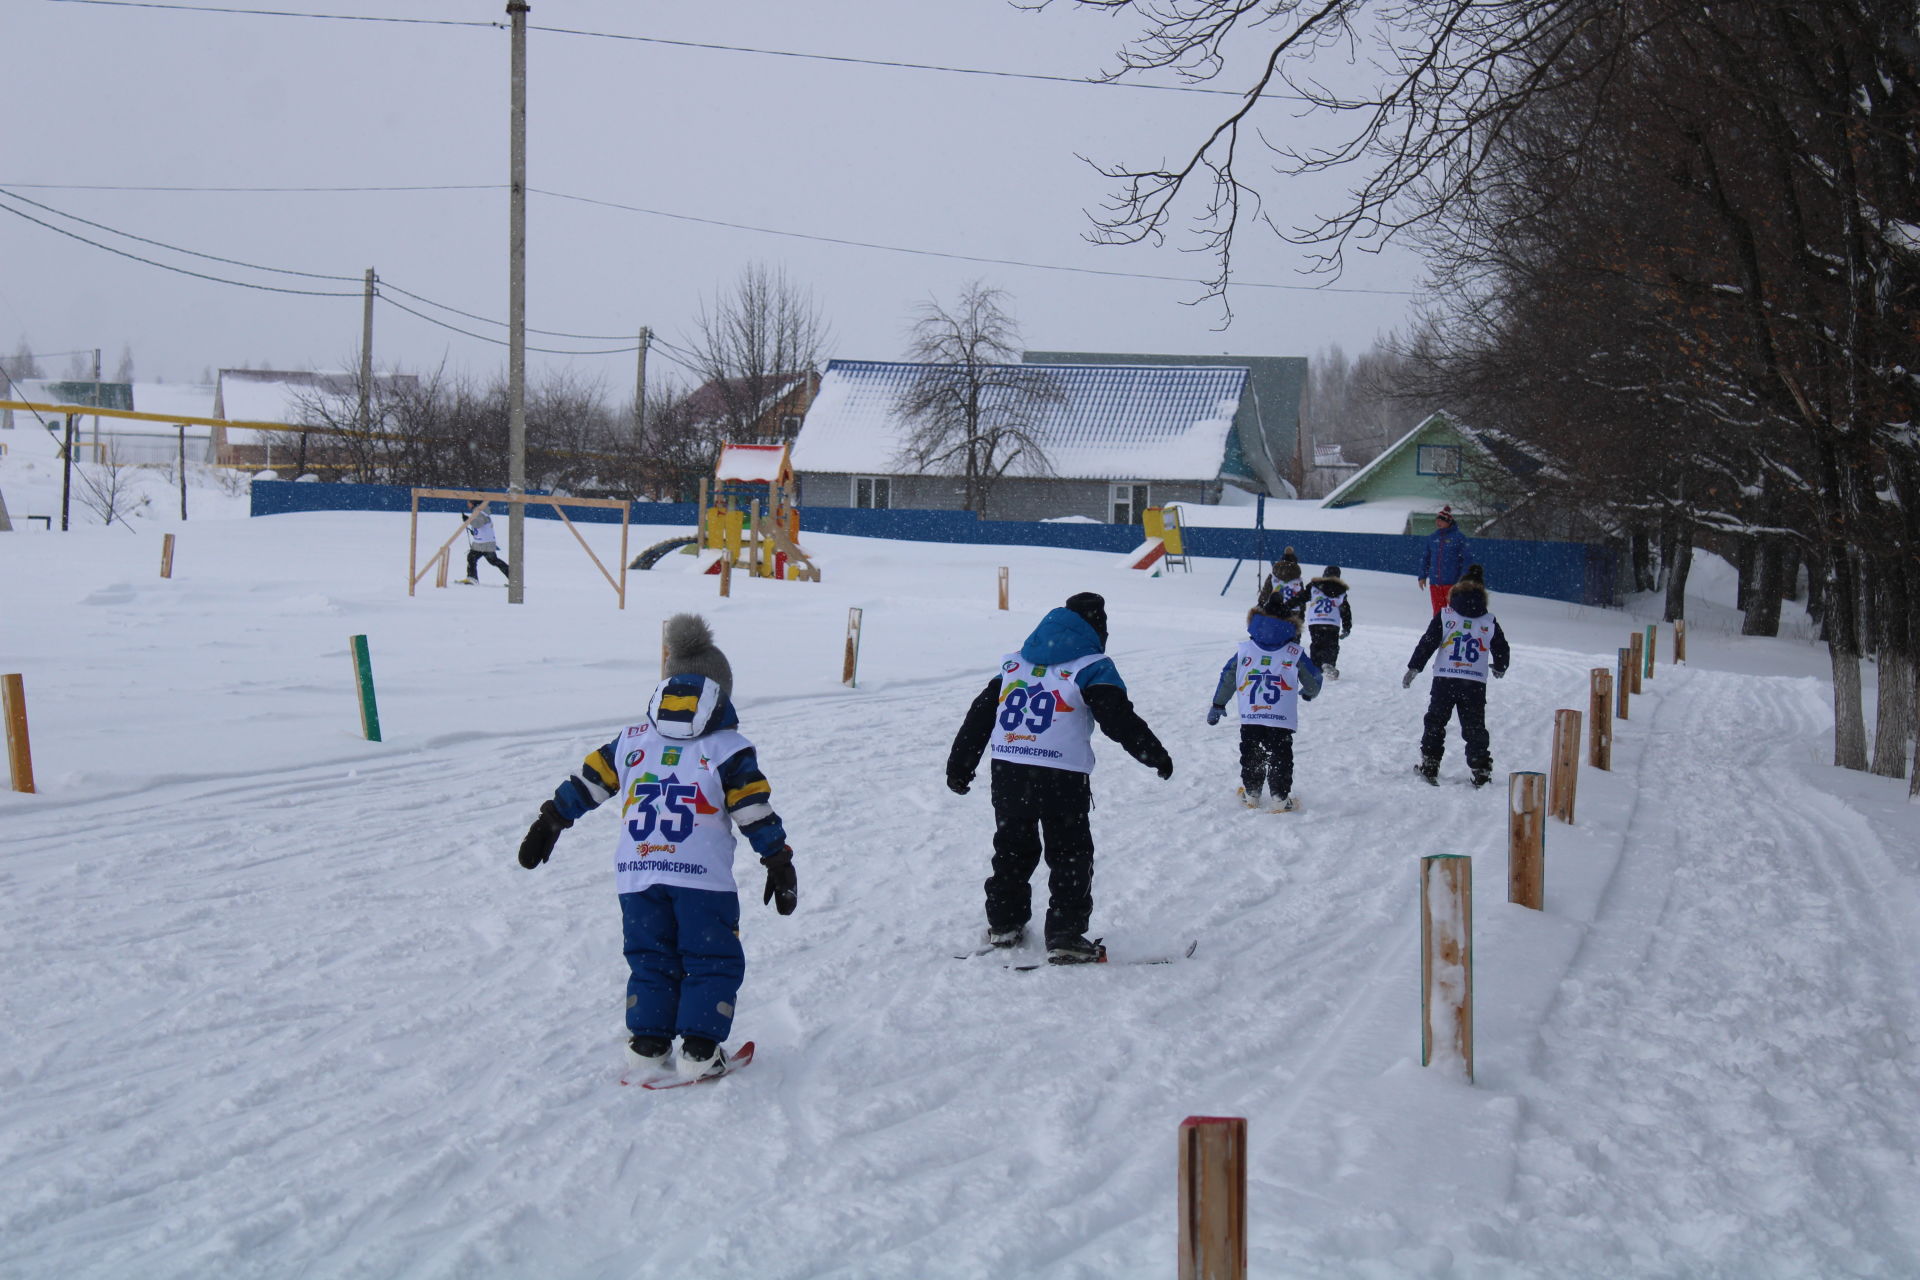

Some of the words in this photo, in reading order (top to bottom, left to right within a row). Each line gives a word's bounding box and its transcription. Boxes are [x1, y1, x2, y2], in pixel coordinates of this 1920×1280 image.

[1314, 599, 1333, 614] 28
[1449, 637, 1480, 663] 16
[1248, 674, 1281, 705] 75
[999, 688, 1056, 734] 89
[996, 744, 1063, 758] «ГАЗСТРОЙСЕРВИС»
[628, 783, 695, 843] 35
[628, 859, 708, 875] «ГАЗСТРОЙСЕРВИС»
